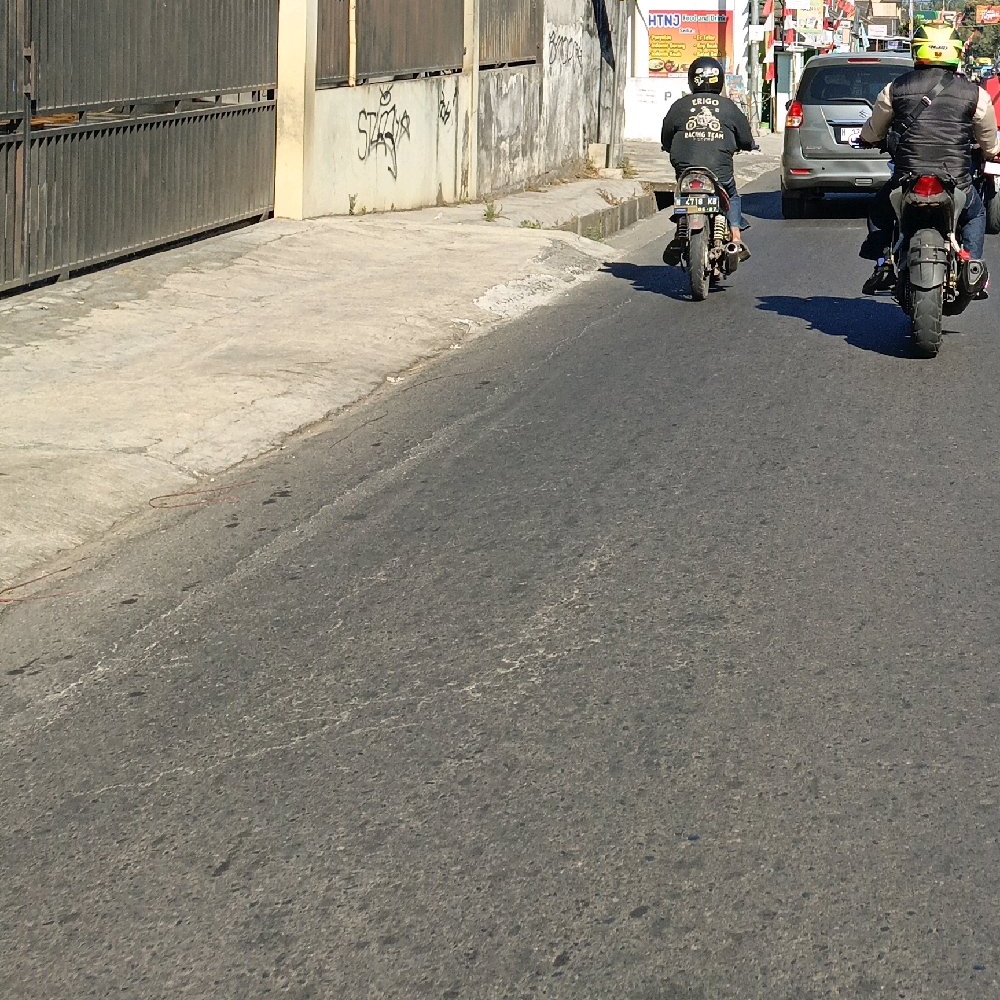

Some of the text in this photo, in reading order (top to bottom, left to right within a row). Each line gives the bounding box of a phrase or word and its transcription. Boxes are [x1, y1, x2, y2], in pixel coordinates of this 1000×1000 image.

[692, 98, 719, 106] ERIGO
[684, 131, 706, 139] RACING
[707, 132, 724, 140] TEAM
